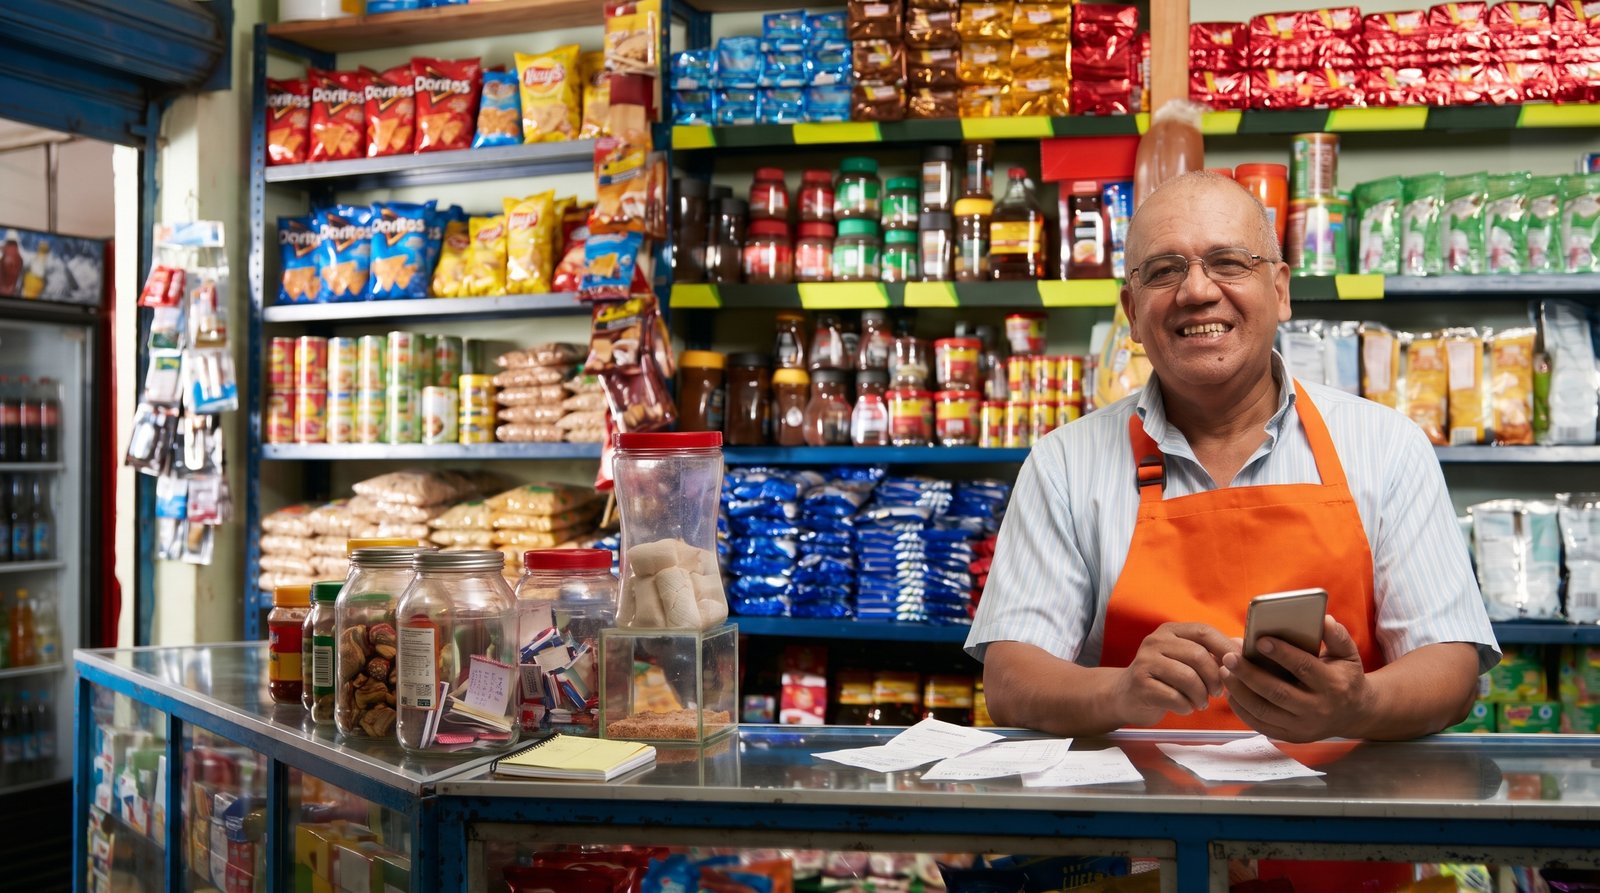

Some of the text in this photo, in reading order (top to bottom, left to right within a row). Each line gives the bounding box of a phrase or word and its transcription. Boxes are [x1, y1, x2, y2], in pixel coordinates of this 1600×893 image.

[365, 84, 414, 100] Doritos
[415, 76, 470, 94] Doritos
[267, 93, 310, 109] oritos
[312, 87, 365, 104] Doritos
[372, 217, 425, 233] Doritos
